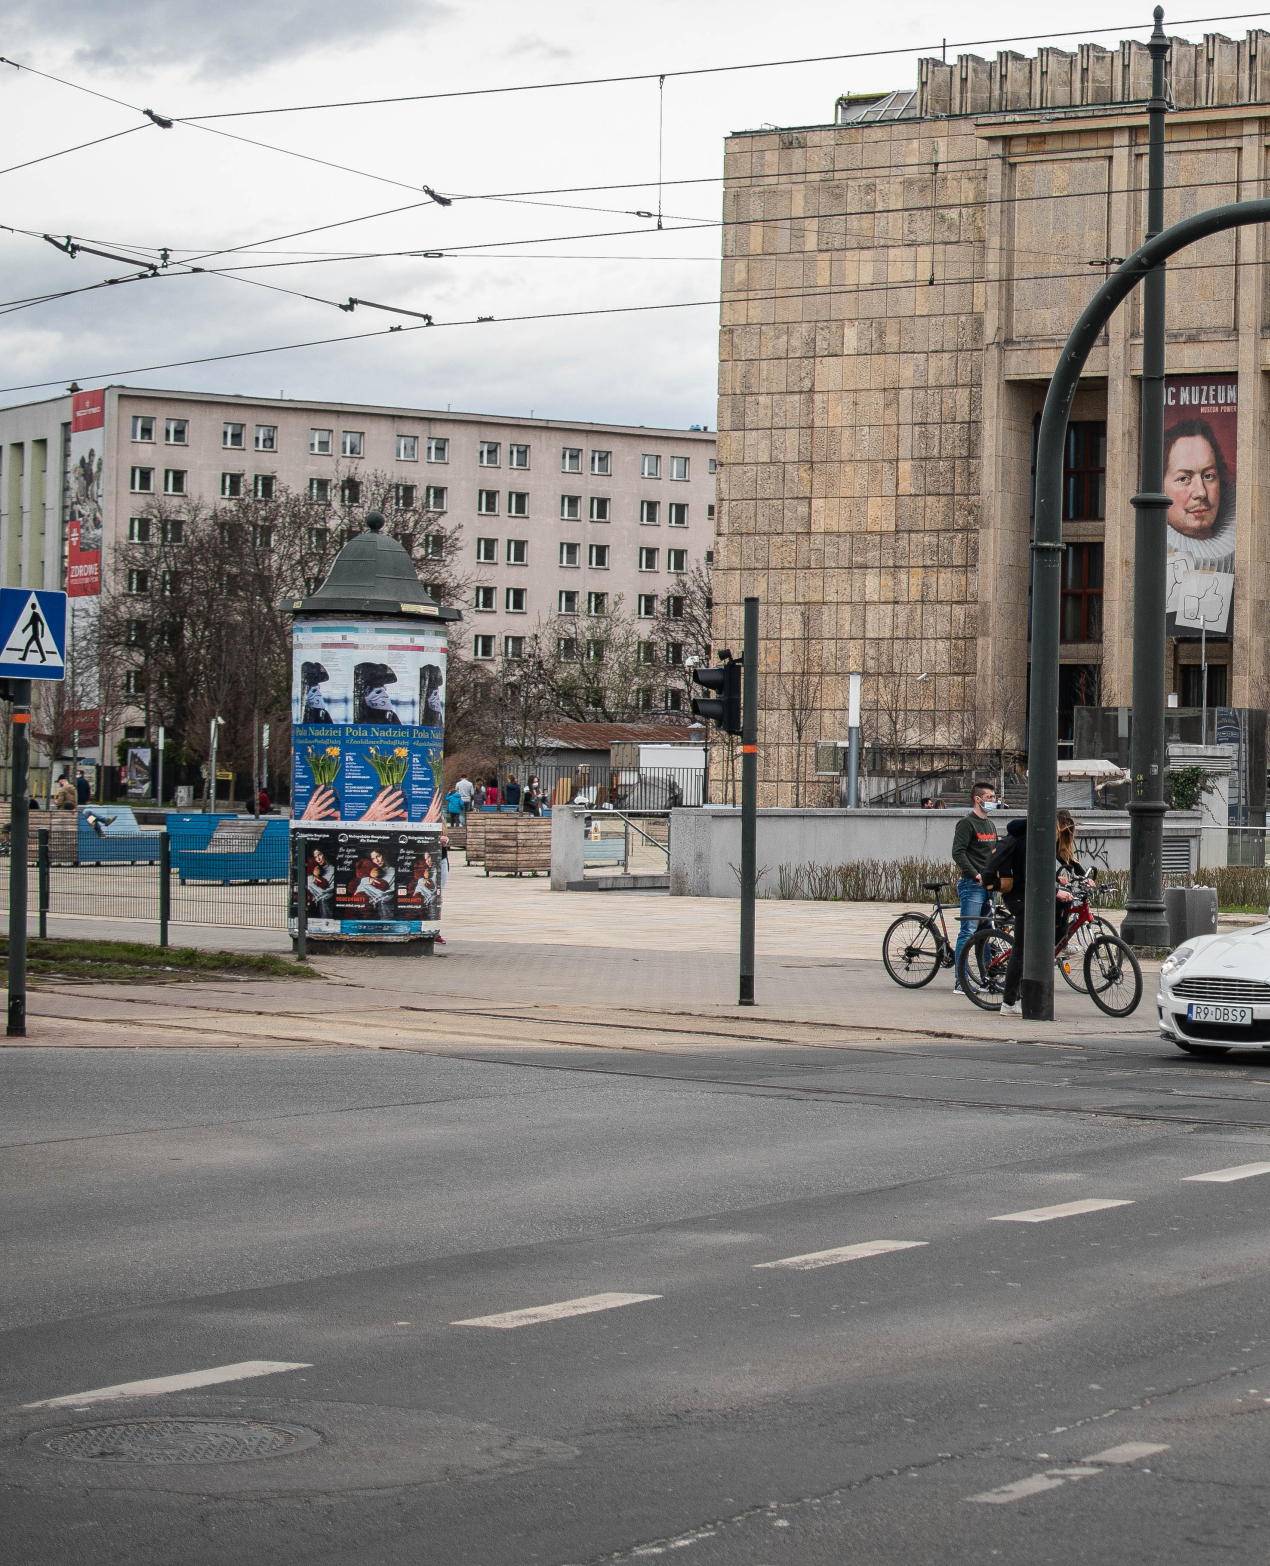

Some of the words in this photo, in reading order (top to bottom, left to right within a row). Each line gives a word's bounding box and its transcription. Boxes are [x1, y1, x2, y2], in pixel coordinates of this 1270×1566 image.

[1180, 385, 1237, 405] MUZEUM
[308, 726, 342, 737] Nadziei
[345, 726, 368, 737] Pola
[370, 726, 410, 738] Nadziei
[412, 728, 429, 739] Pola
[1195, 1006, 1210, 1020] R9
[1214, 1007, 1247, 1023] DBS9
